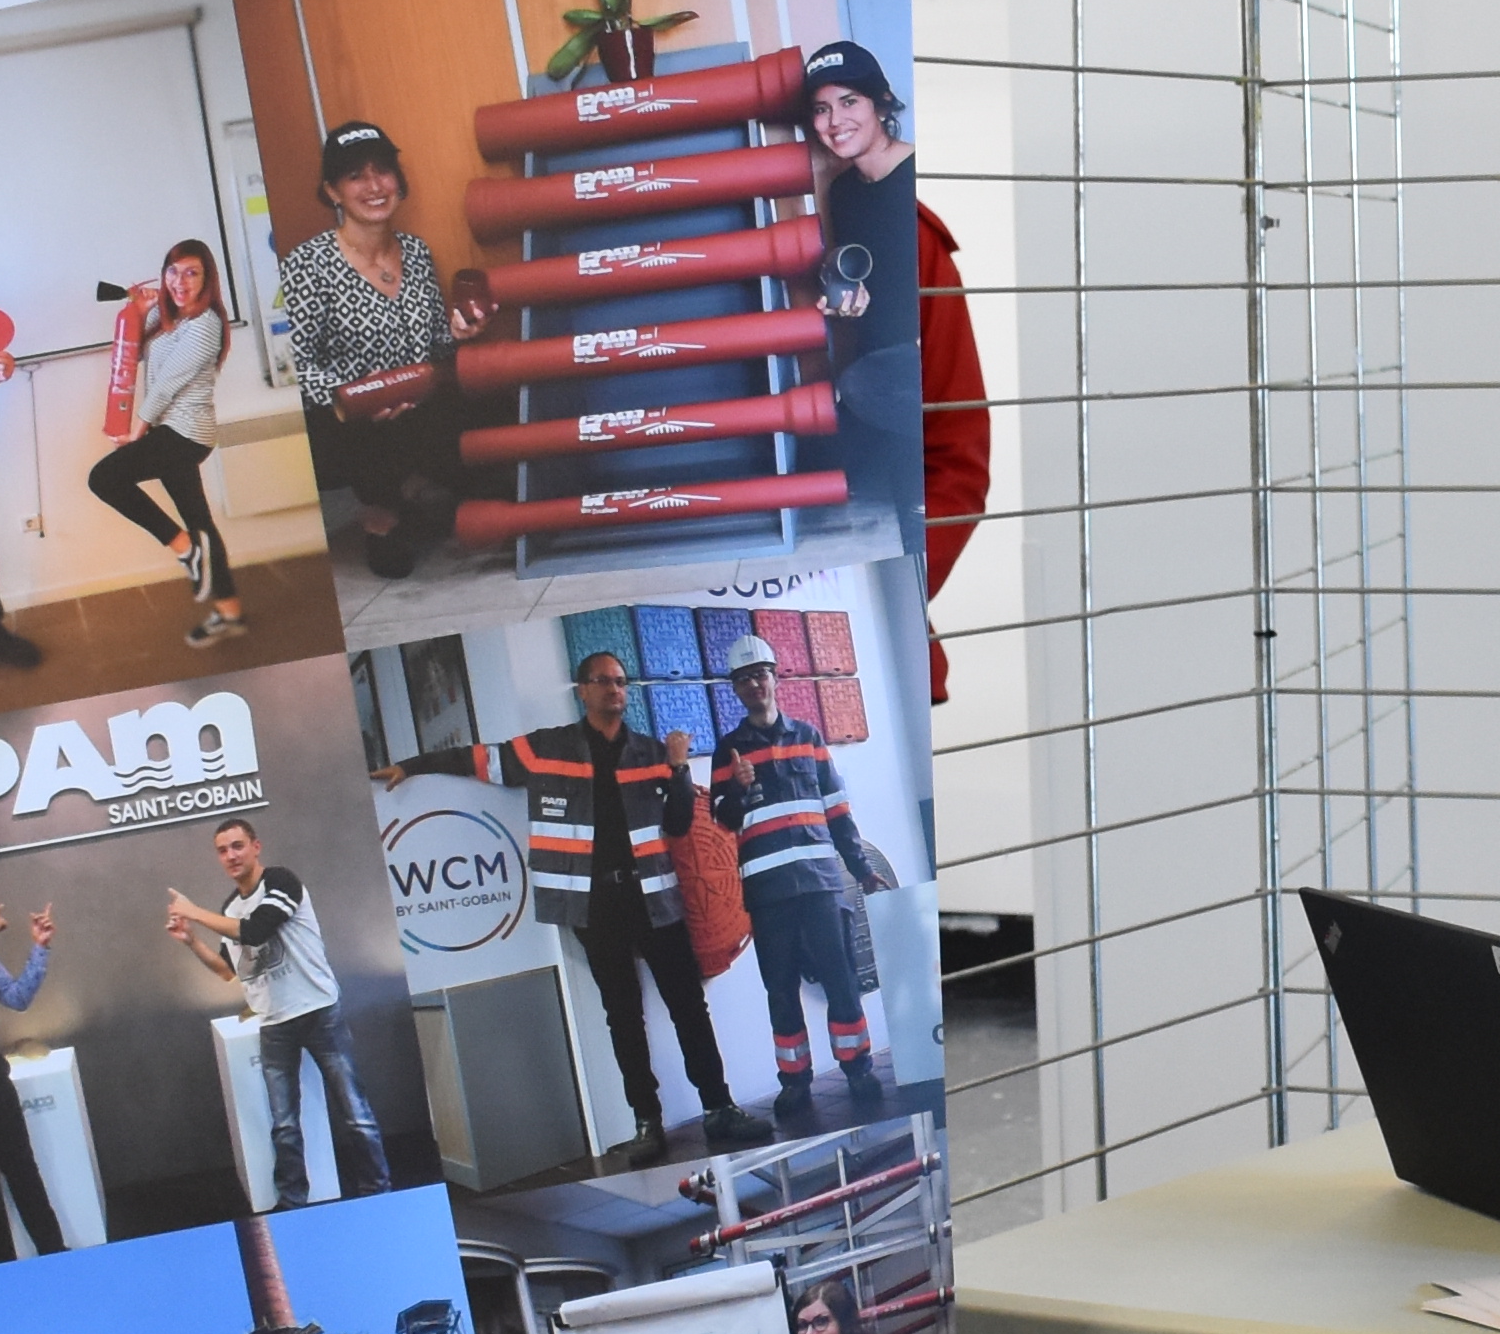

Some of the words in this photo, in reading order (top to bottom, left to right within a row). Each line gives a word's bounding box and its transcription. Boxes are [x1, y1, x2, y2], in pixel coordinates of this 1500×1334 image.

[107, 778, 264, 826] SAINT-GOBAIN
[388, 850, 509, 898] WCM
[395, 905, 414, 918] BY
[417, 890, 512, 915] SAINT-GOBAIN
